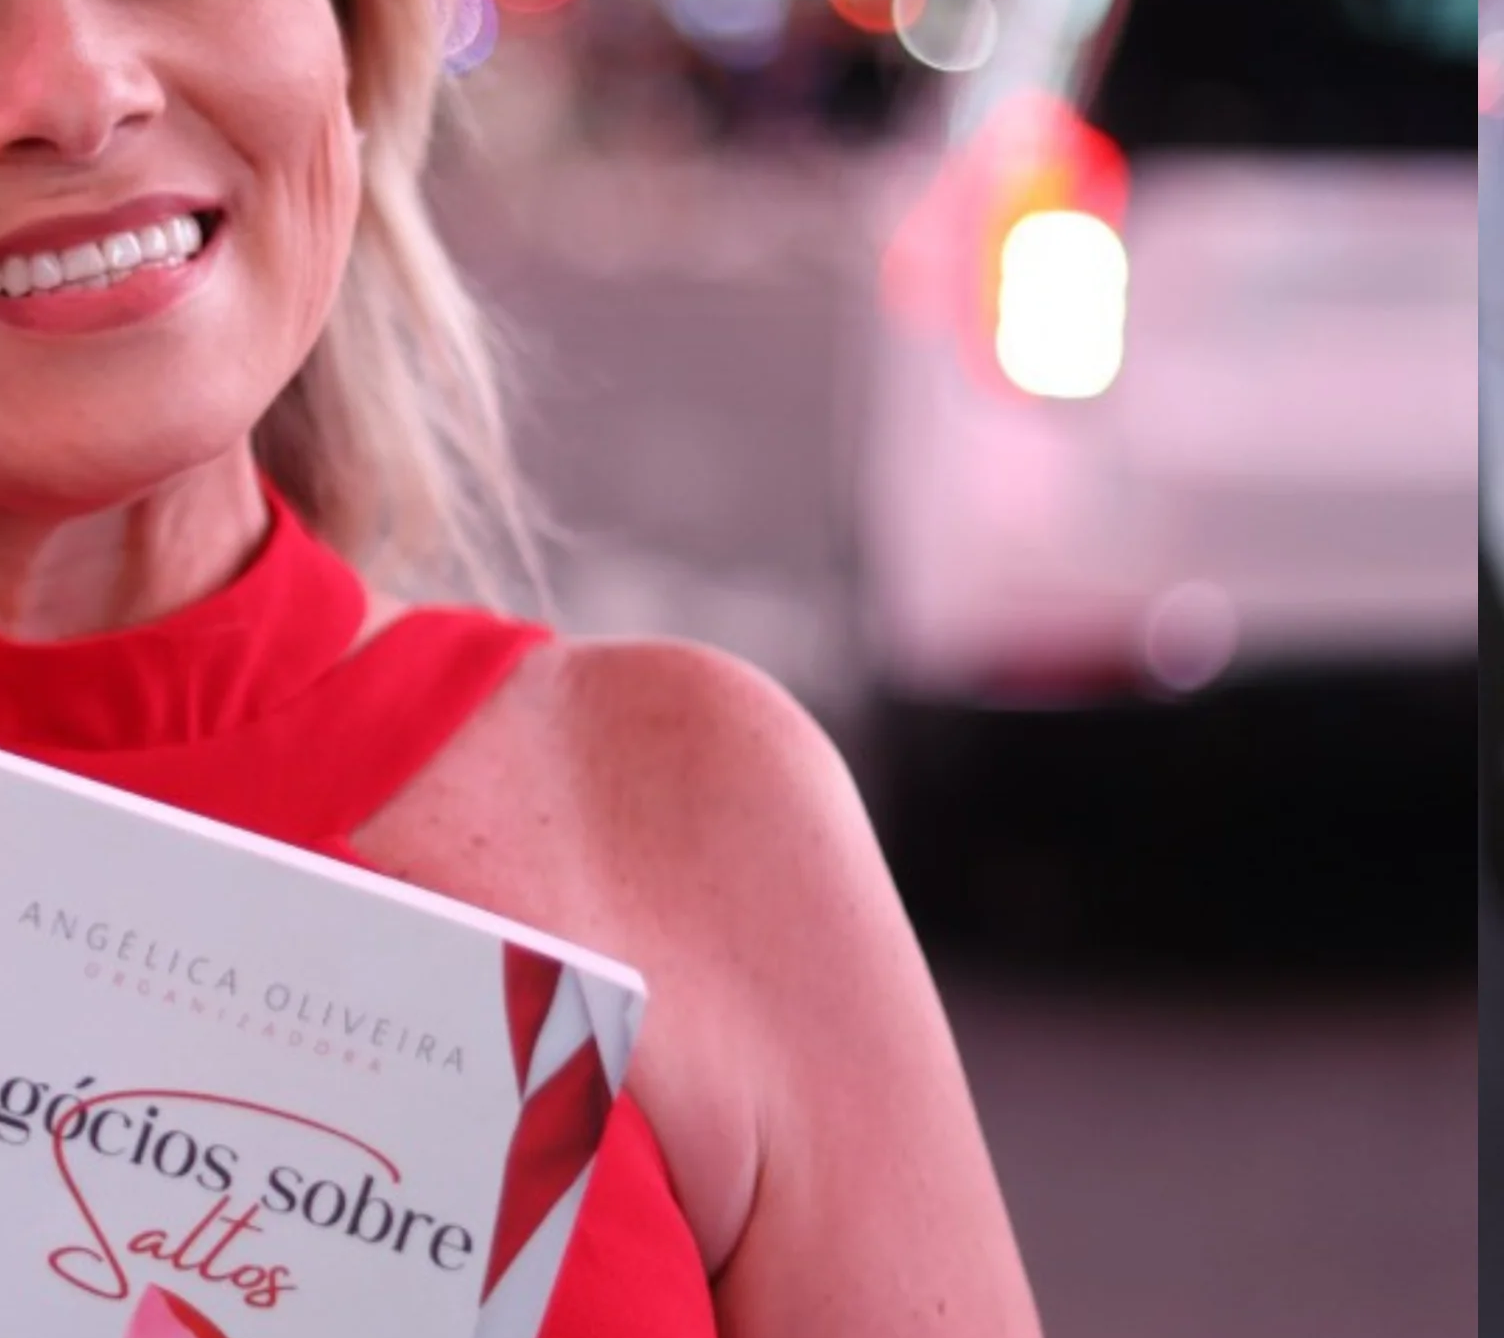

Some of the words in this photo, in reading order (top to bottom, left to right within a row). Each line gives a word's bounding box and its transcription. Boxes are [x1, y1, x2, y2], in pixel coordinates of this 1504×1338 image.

[19, 900, 239, 996] ANGÉLICA
[264, 983, 466, 1075] OLIVEIRA
[48, 1090, 402, 1309] Saltos
[261, 1165, 475, 1273] sobre
